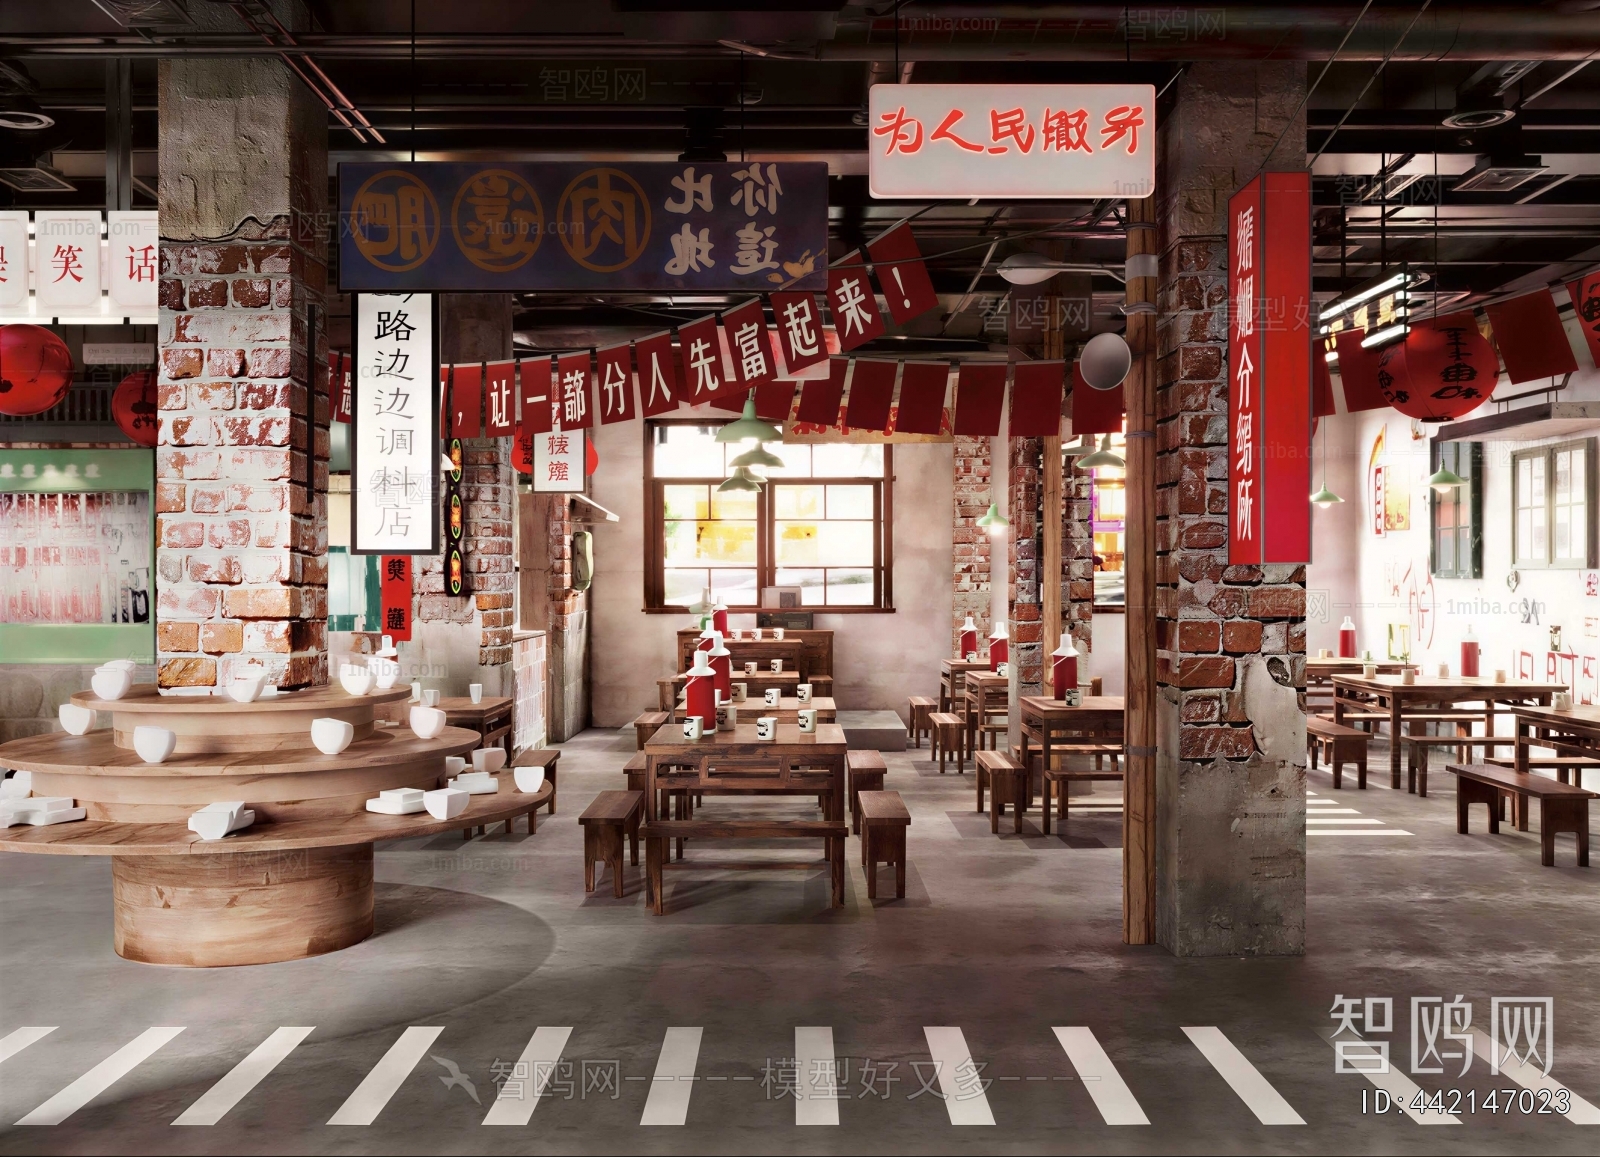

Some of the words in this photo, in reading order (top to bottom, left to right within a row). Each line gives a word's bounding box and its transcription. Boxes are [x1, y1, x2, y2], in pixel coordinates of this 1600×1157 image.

[372, 293, 417, 537] 路边边调料店
